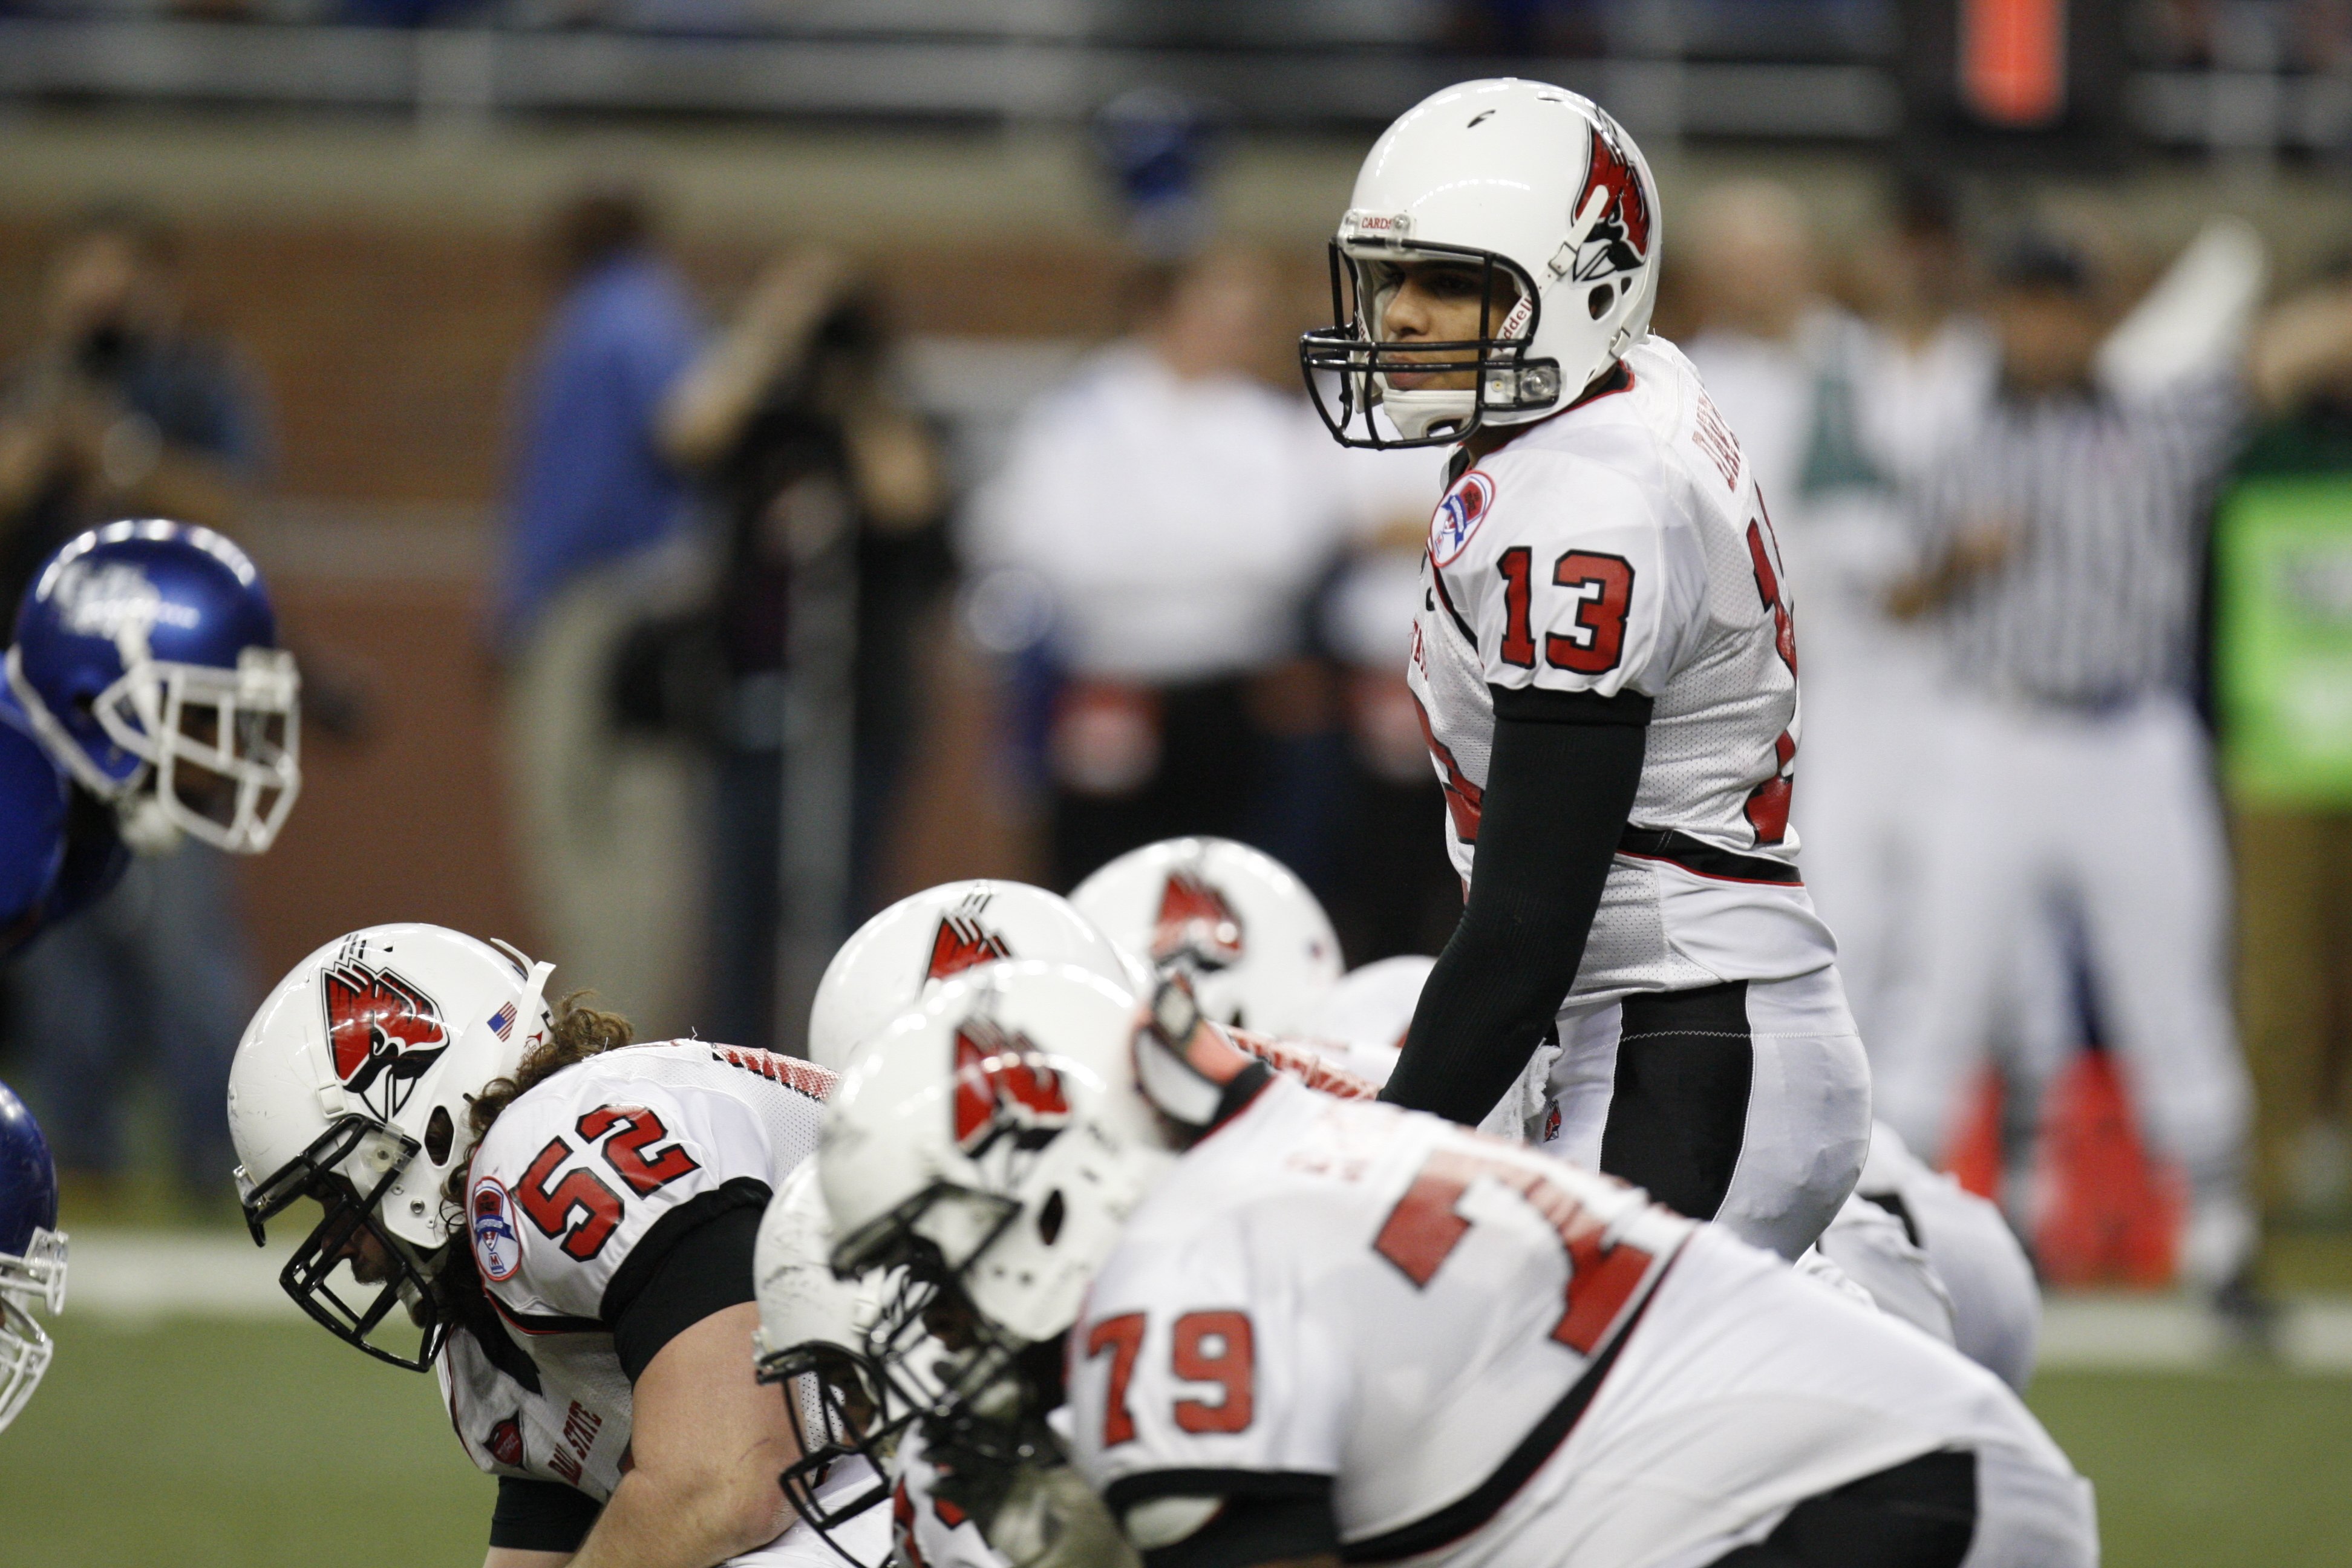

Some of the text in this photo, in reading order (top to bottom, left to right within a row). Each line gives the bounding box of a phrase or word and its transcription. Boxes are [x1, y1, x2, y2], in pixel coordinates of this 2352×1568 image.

[1498, 296, 1532, 352] ddell
[1497, 546, 1636, 676] 13
[510, 1103, 701, 1263] 52
[563, 1400, 603, 1460] STATE
[1085, 1309, 1256, 1448] 79
